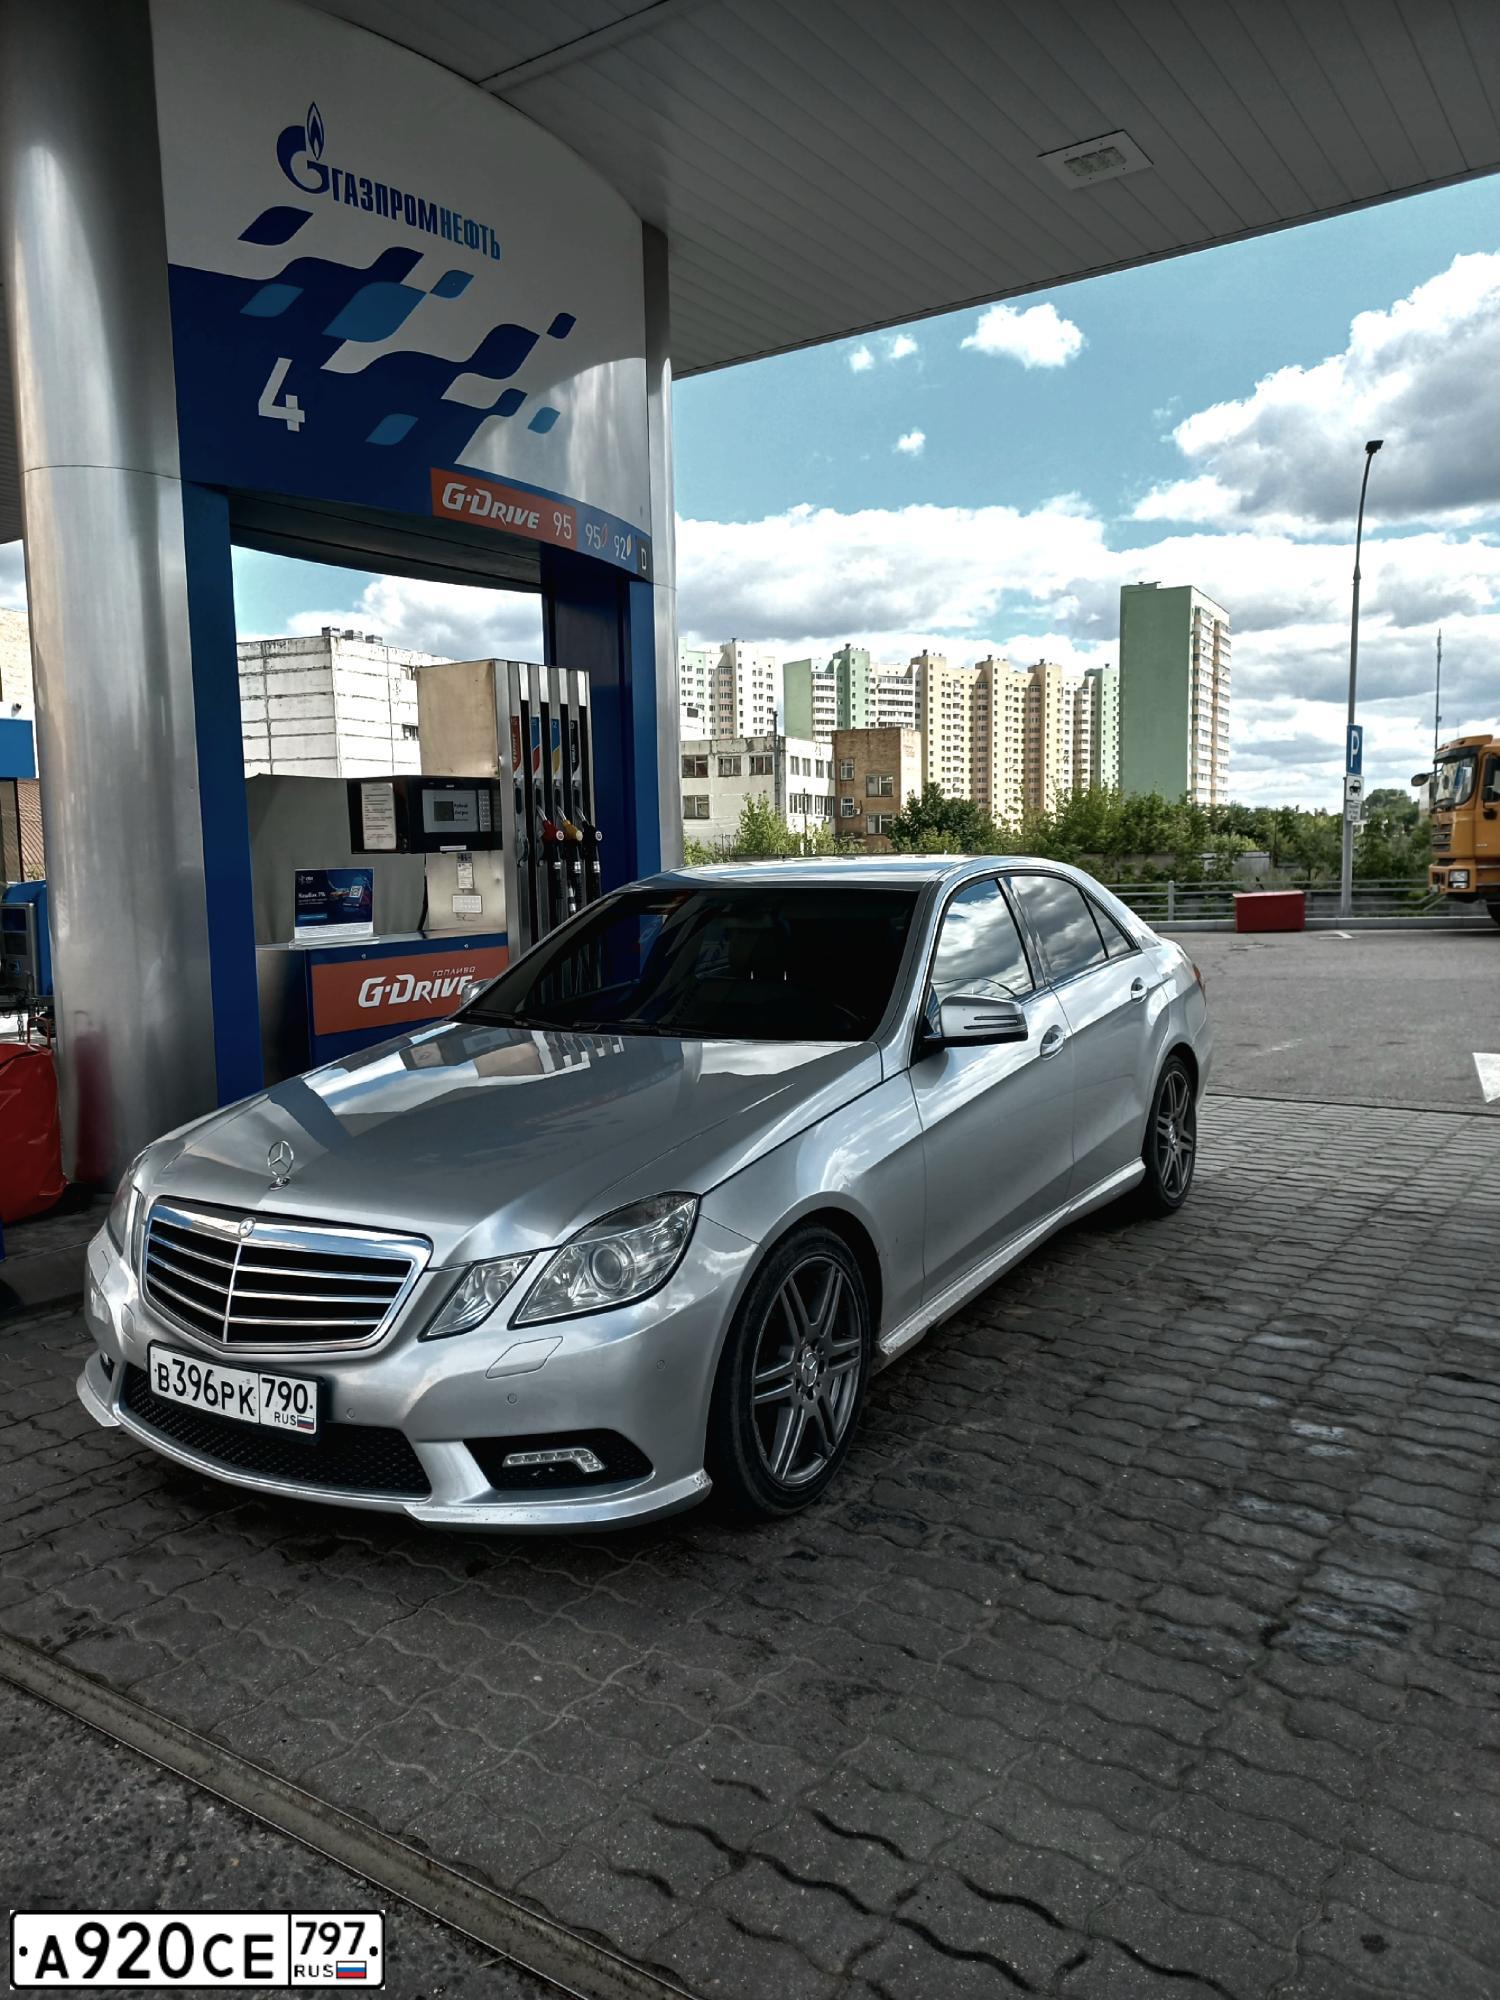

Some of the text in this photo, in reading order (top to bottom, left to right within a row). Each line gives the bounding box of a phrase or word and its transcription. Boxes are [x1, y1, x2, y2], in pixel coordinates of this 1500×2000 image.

[332, 168, 500, 260] ГАЗПРОМНЕФТЬ
[258, 357, 305, 432] 4
[553, 512, 572, 539] 95
[585, 523, 600, 549] 95
[614, 535, 626, 560] 92
[1350, 730, 1360, 768] P
[157, 1358, 308, 1416] В396РК 790
[274, 1411, 296, 1426] RUS
